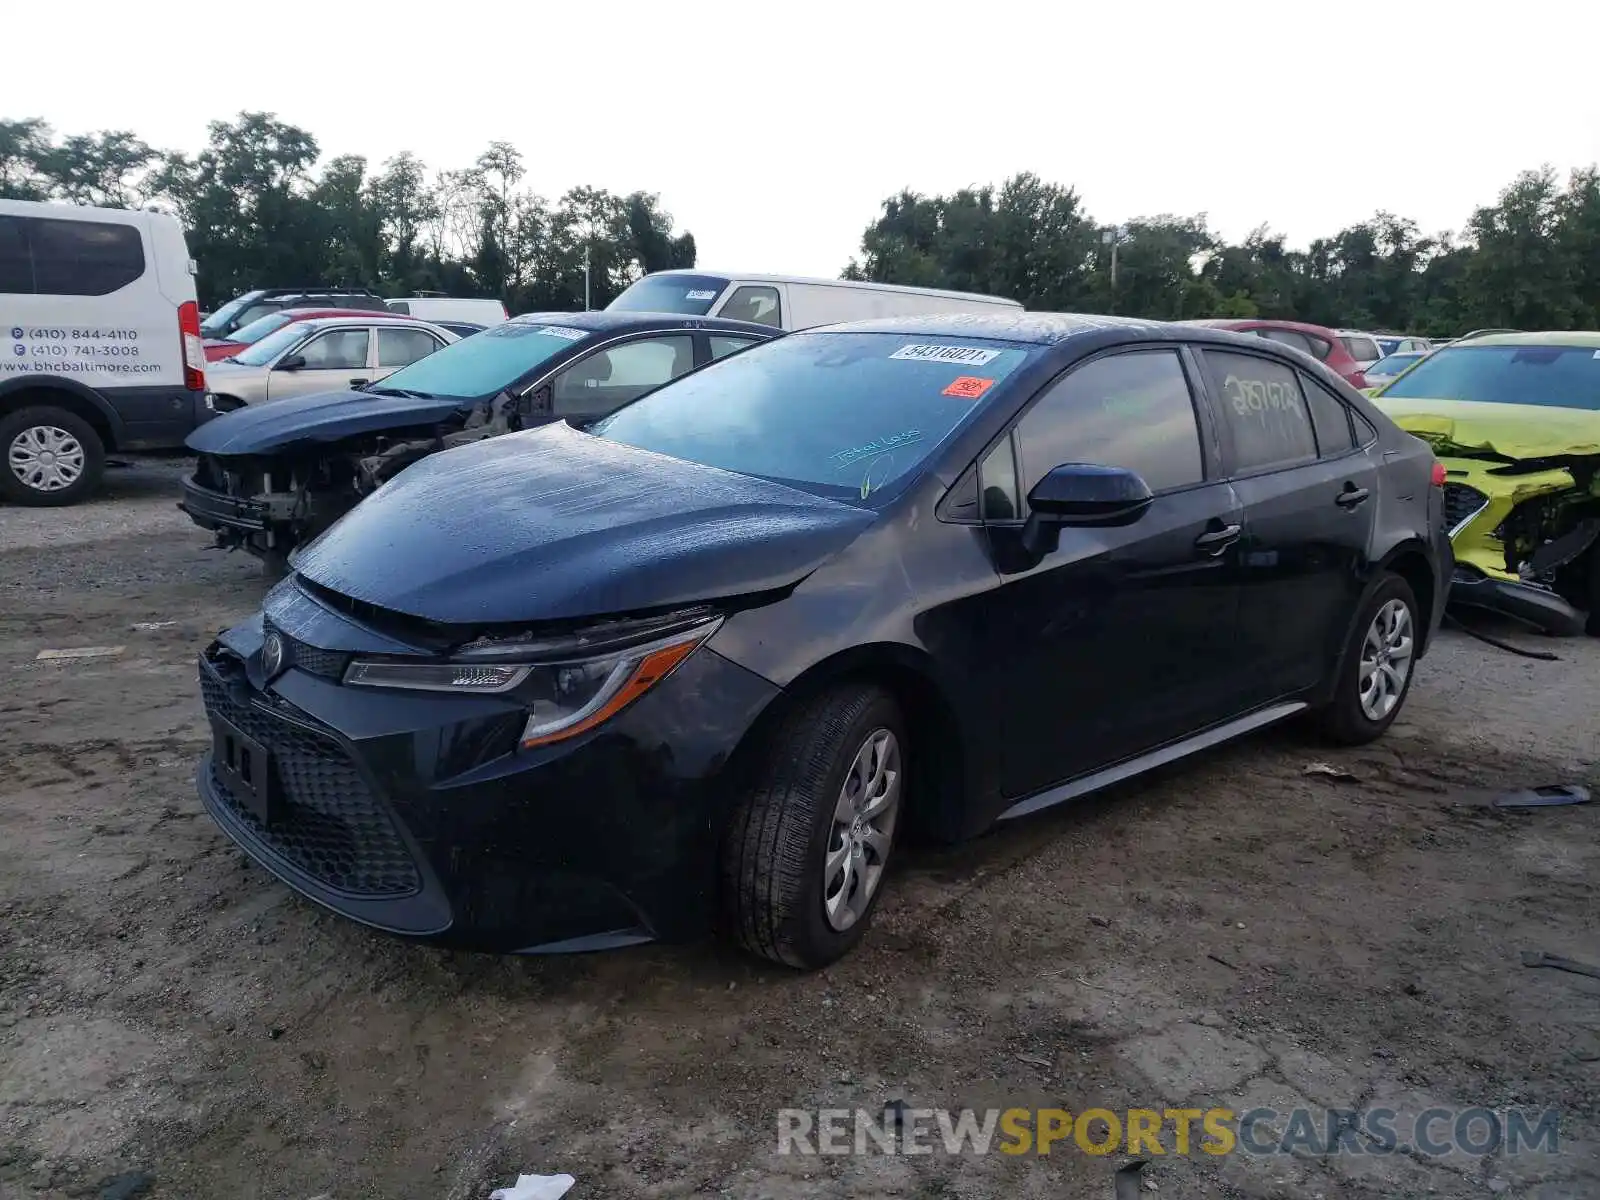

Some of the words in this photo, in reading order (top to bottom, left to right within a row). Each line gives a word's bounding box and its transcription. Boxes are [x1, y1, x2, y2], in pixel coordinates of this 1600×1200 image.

[28, 329, 66, 340] (410)
[71, 329, 138, 340] 844-4110
[31, 345, 68, 356] (410)
[73, 345, 140, 356] 741-3008
[0, 360, 161, 373] ww.bhcbaltimore.com
